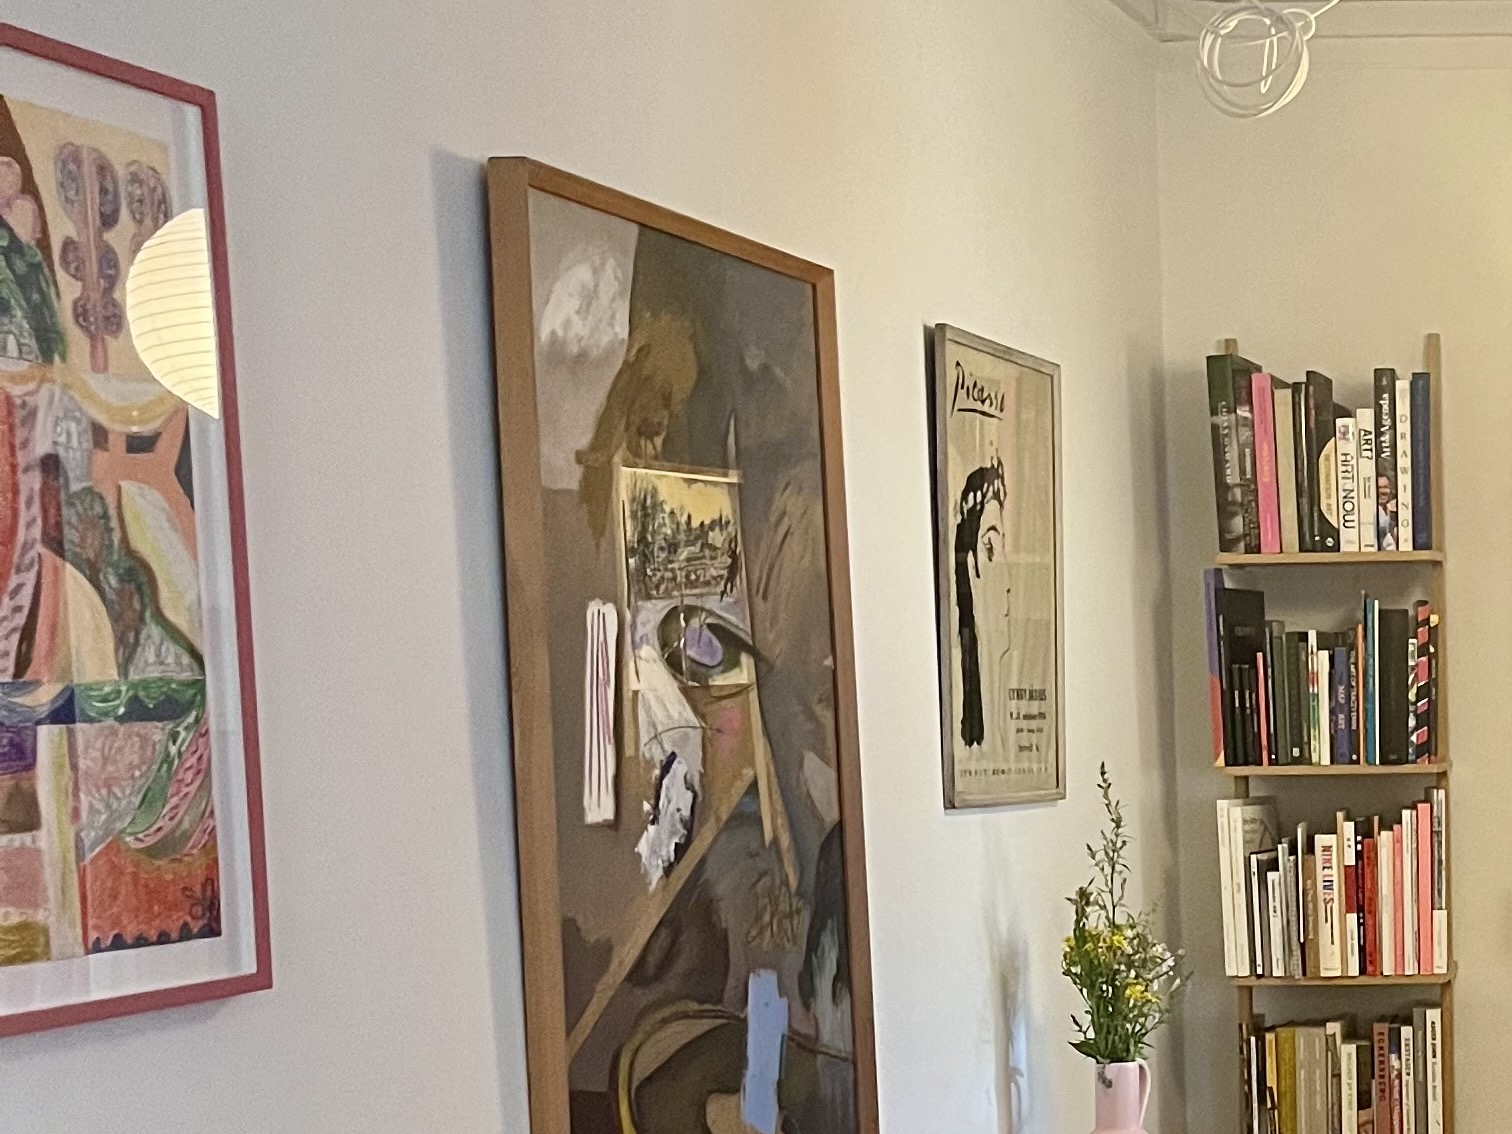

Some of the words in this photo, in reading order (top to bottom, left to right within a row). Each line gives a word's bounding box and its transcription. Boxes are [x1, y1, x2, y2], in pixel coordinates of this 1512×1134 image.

[1359, 429, 1374, 461] ART?
[1340, 452, 1355, 483] ART
[1342, 485, 1357, 530] NOW
[1377, 1031, 1388, 1103] ECKERSBERG
